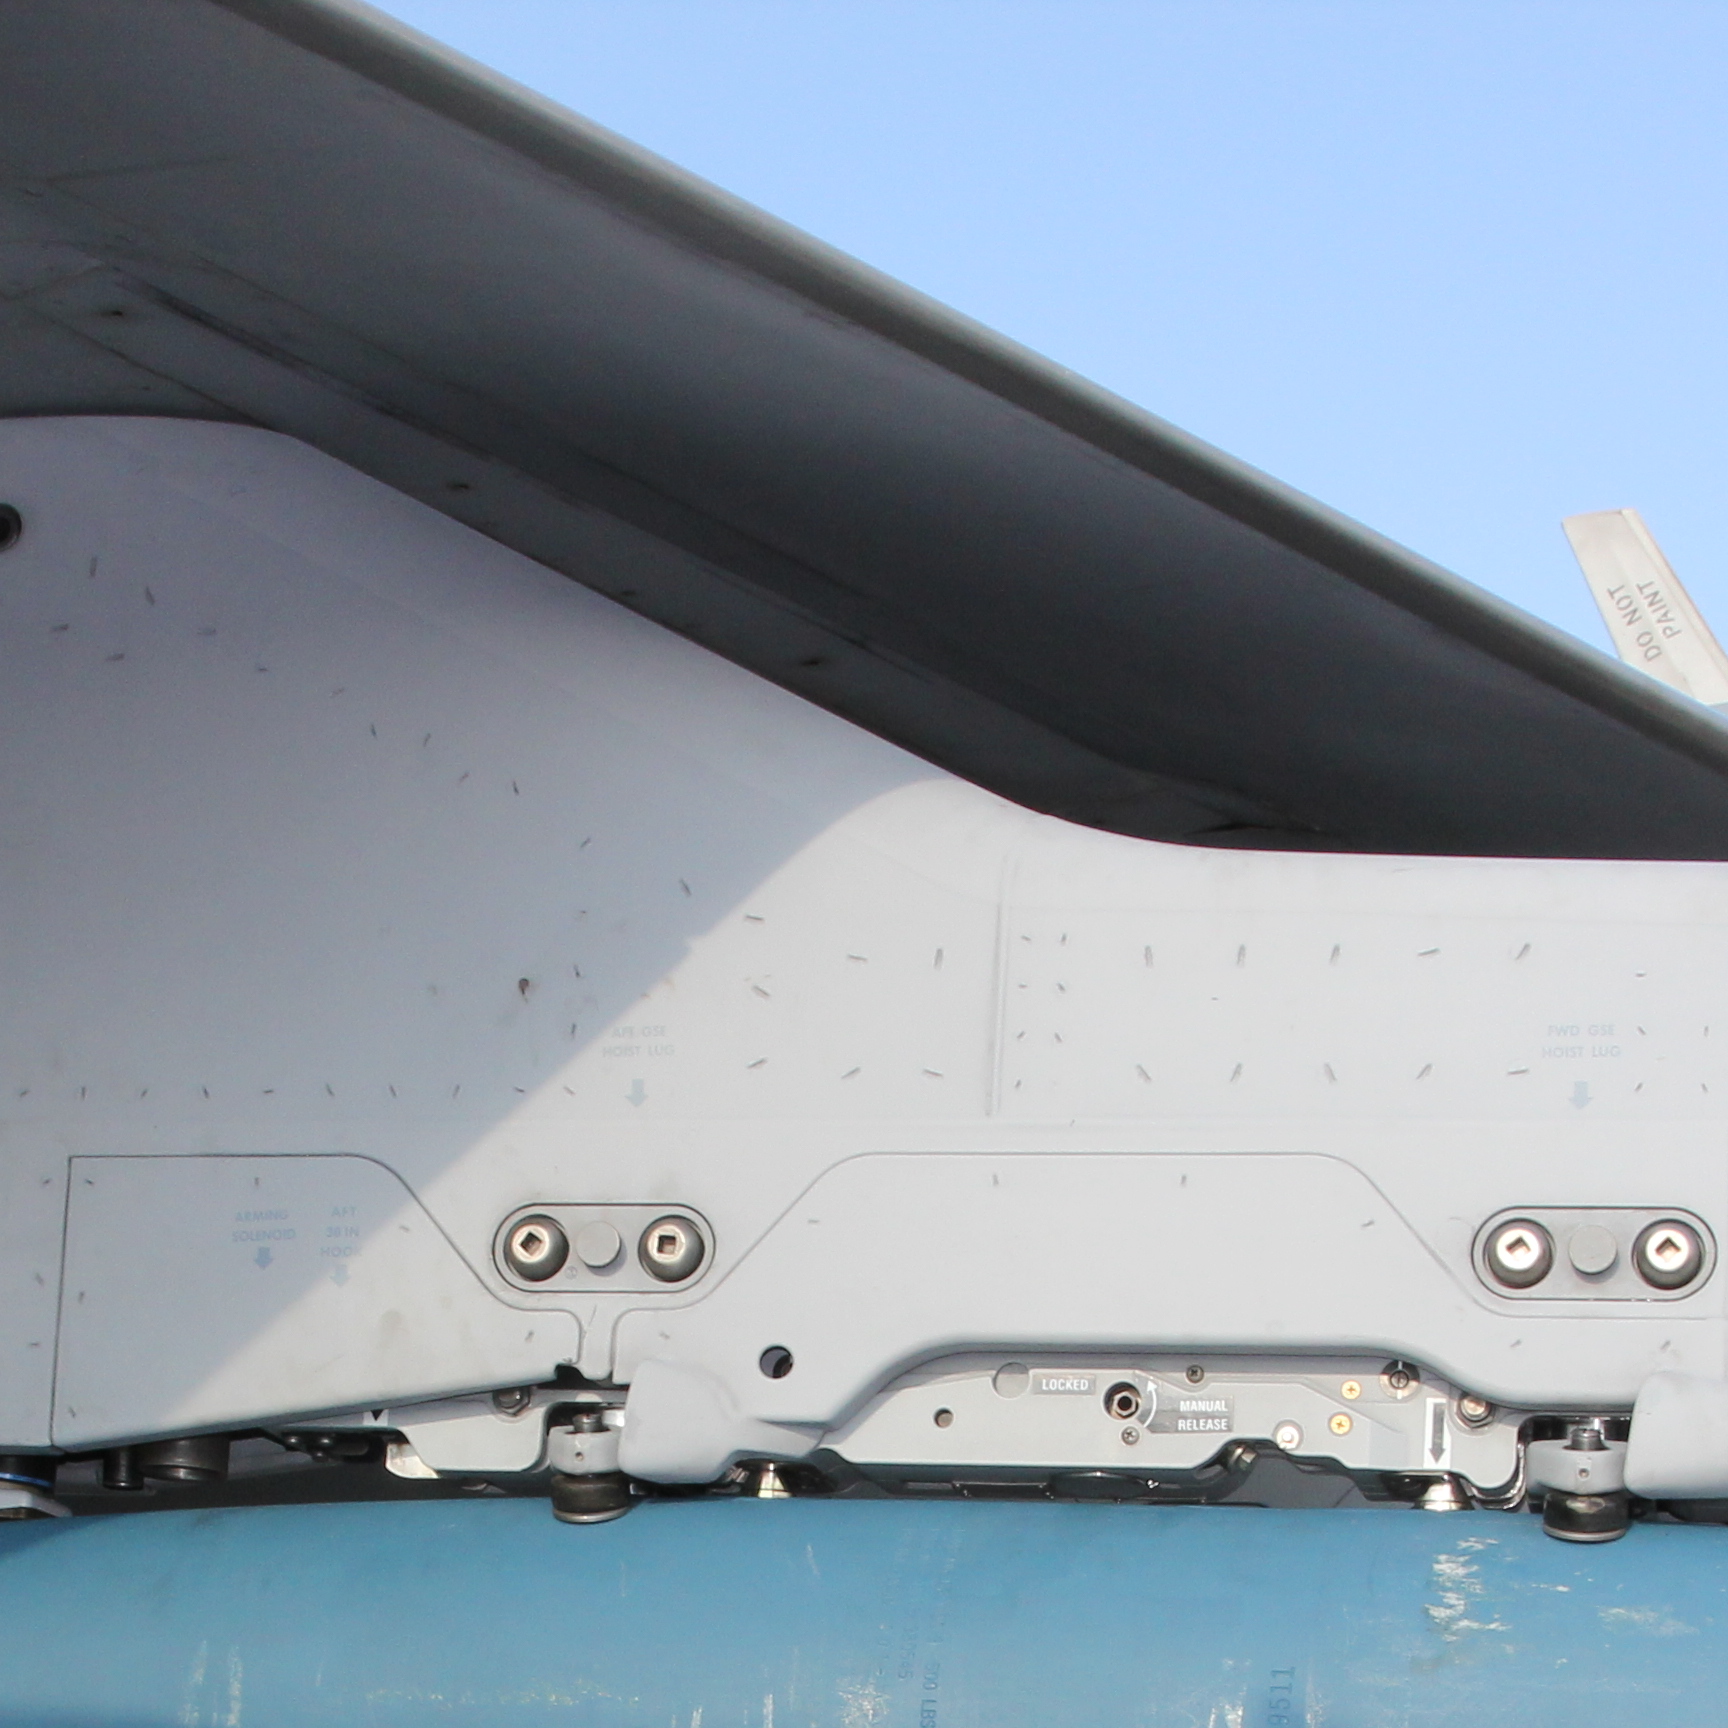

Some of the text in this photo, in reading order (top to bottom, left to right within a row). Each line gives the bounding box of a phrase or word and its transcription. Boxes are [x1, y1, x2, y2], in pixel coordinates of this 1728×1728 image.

[1637, 581, 1682, 638] PAINT
[1607, 584, 1663, 662] DO NOT
[1547, 1023, 1615, 1037] FWD GSE
[1542, 1044, 1622, 1059] HOIST LUG
[1041, 1377, 1089, 1391] LOCKED
[1179, 1399, 1228, 1413] MANUAL
[1178, 1417, 1229, 1432] RELEASE
